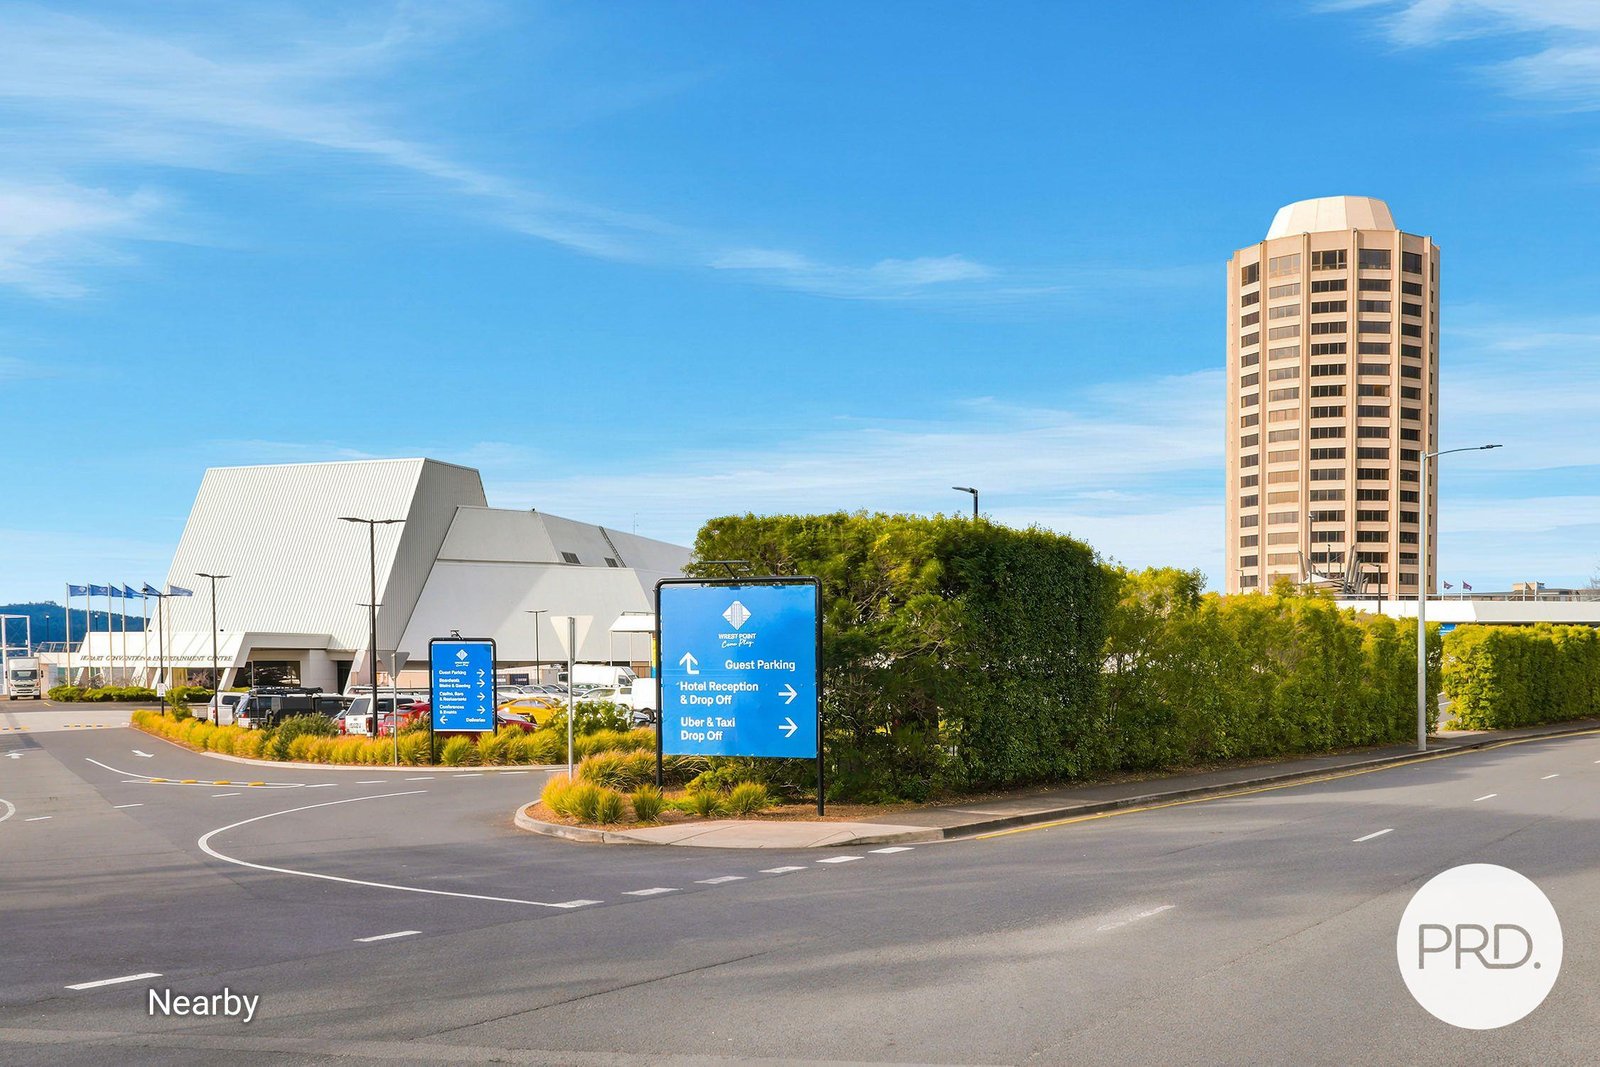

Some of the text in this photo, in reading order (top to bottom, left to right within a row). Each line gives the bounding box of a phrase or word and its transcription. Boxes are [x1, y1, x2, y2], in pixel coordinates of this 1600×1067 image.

[738, 639, 754, 648] Play
[725, 659, 796, 672] Guest Parking
[680, 681, 759, 694] Hotel Reception
[680, 694, 733, 707] & Drop Off
[680, 716, 736, 727] Uber & Taxi
[680, 729, 724, 743] Drop Off
